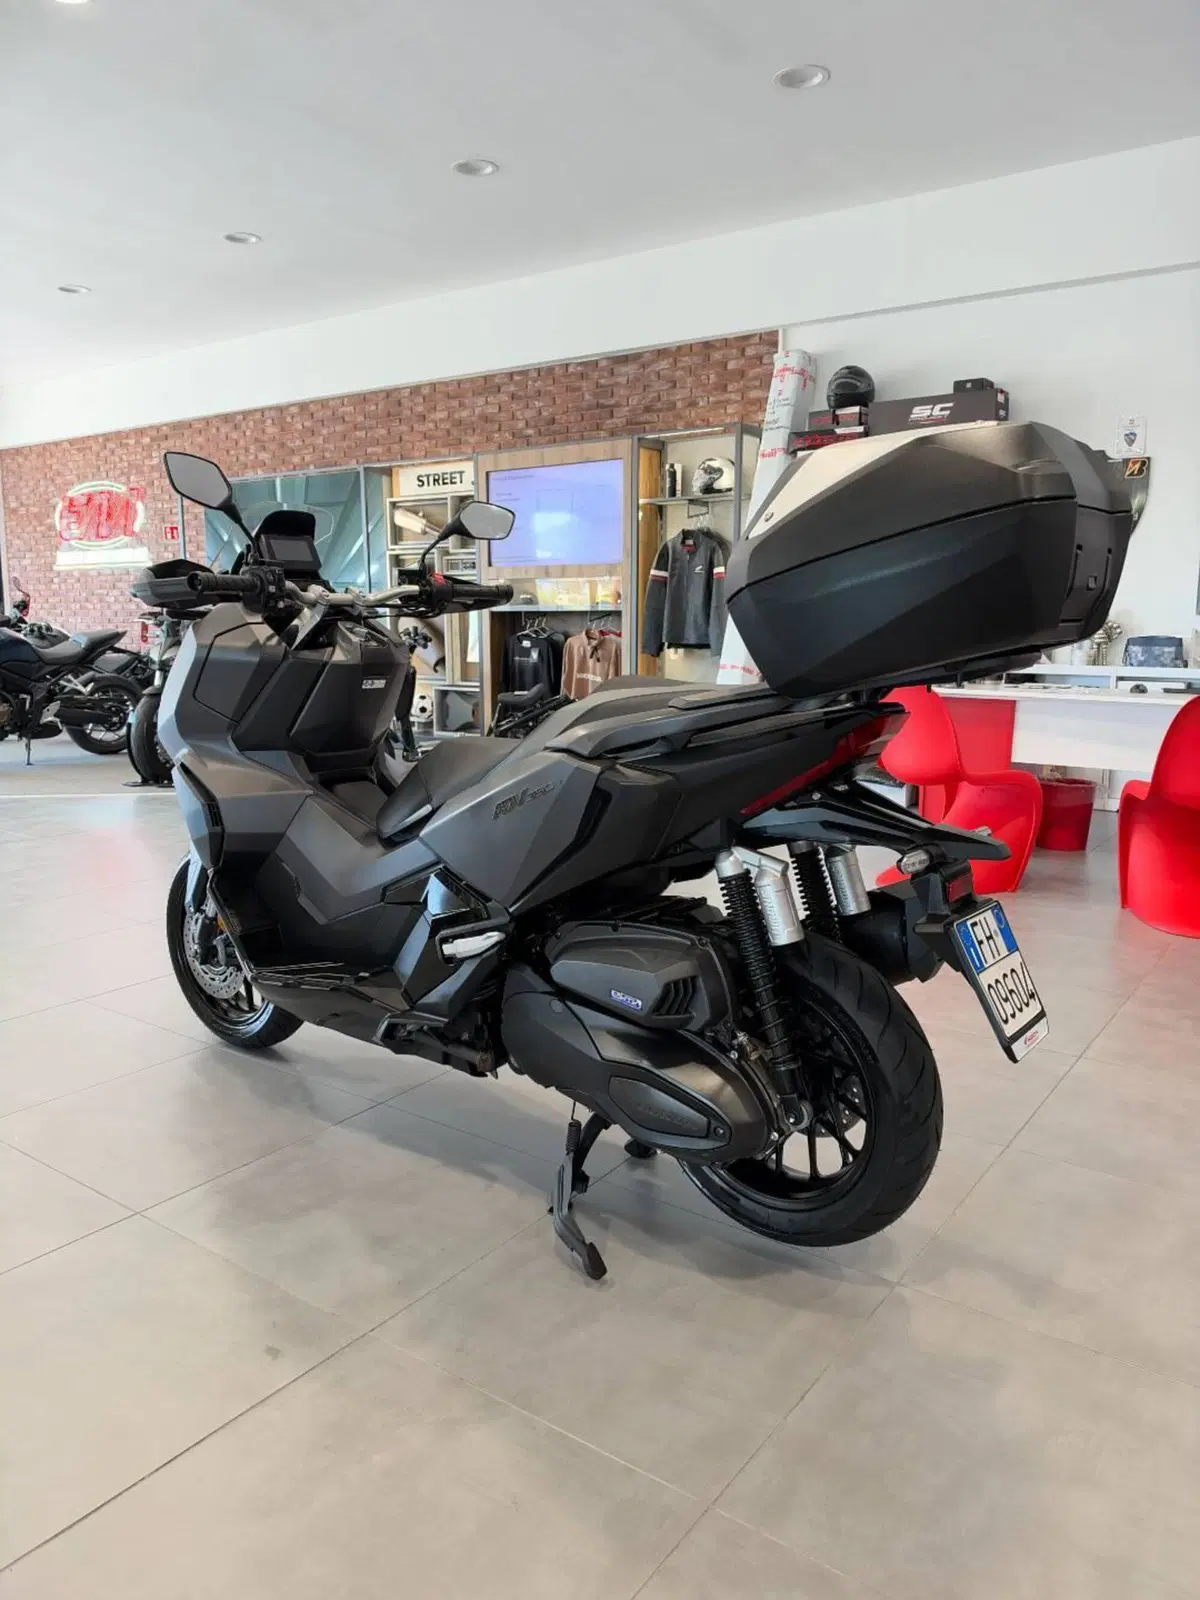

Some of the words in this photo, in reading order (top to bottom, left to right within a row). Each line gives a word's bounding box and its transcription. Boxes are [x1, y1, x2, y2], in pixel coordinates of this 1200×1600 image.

[909, 402, 955, 419] SC
[416, 470, 466, 488] STREET
[970, 916, 1001, 965] FH
[987, 961, 1036, 1025] 09604
